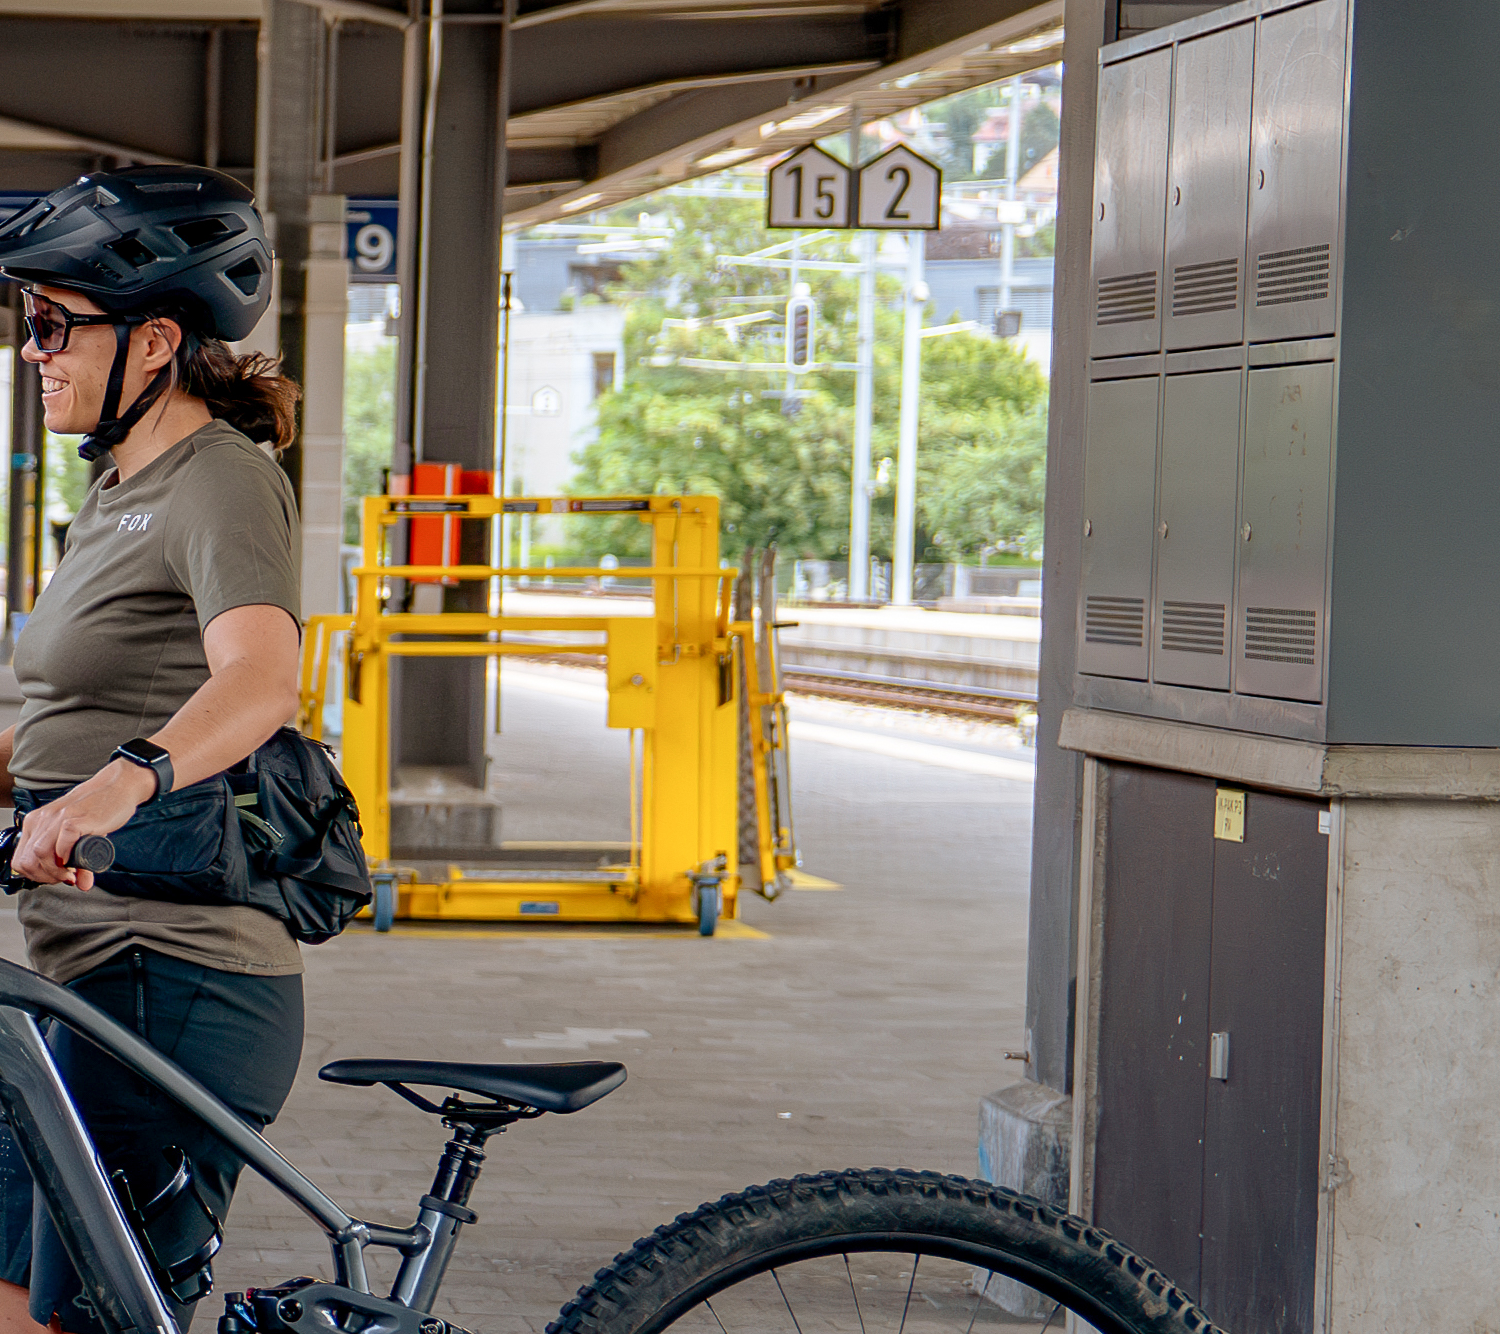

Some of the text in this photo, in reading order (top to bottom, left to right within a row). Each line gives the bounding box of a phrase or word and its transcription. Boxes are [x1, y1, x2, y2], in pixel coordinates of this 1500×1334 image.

[885, 163, 911, 219] 2
[355, 224, 394, 272] 9
[116, 513, 153, 532] FOX
